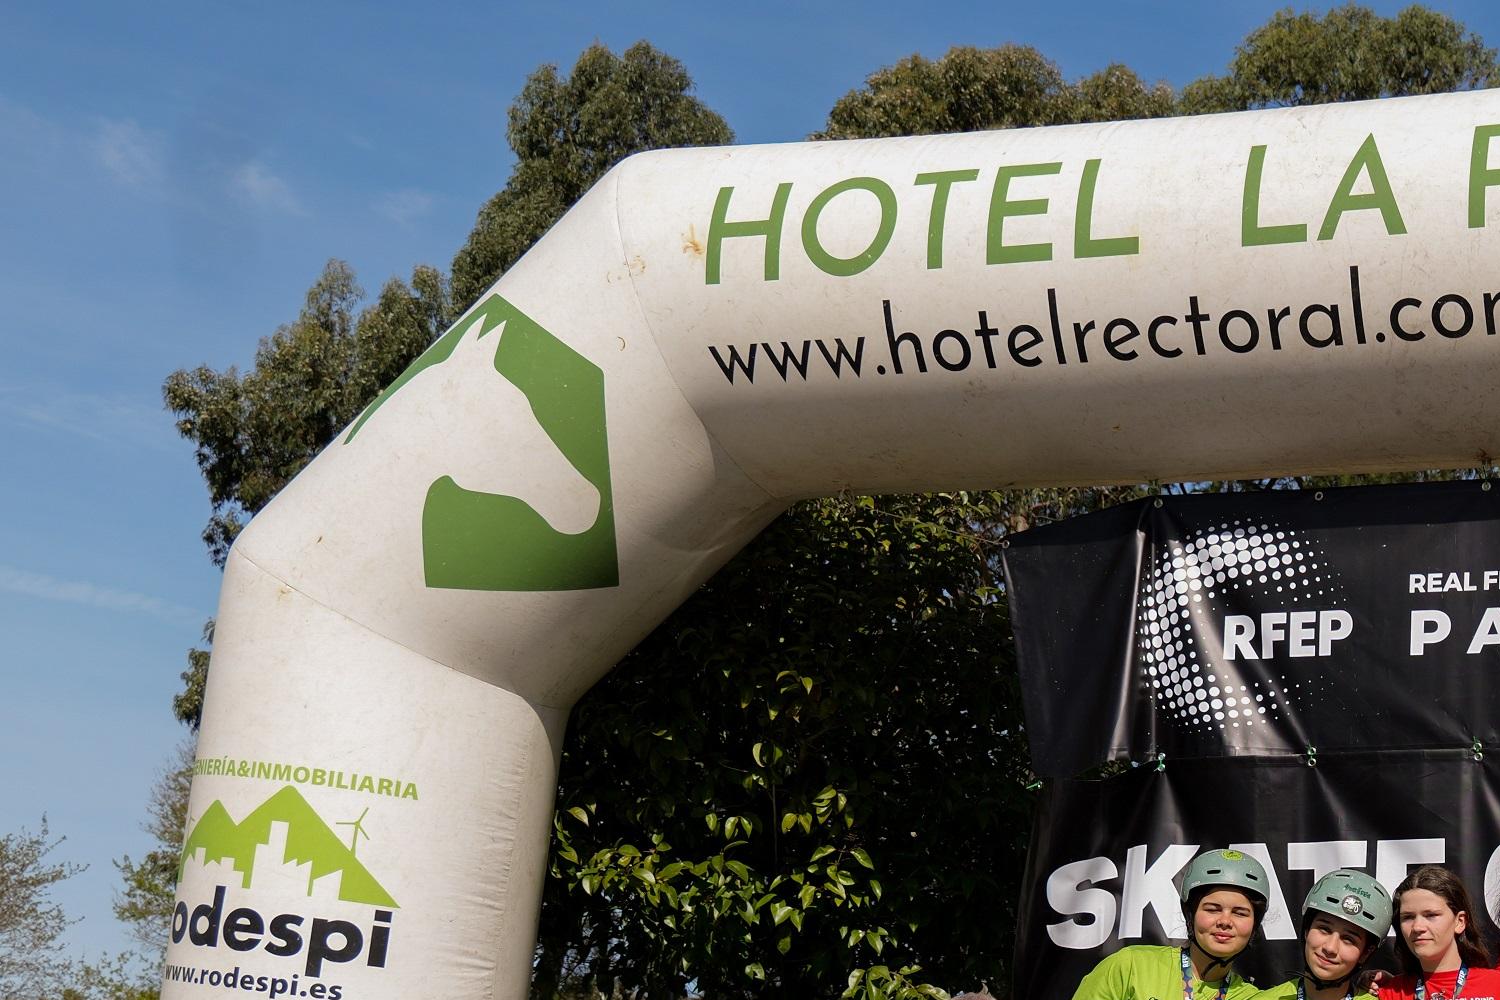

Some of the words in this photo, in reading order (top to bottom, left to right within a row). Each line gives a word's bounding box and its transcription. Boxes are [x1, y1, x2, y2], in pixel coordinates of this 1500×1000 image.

[705, 159, 1140, 285] HOTEL
[1241, 133, 1407, 247] LA
[1409, 571, 1477, 594] REAL
[1223, 610, 1354, 661] RFEP
[172, 885, 393, 978] odespi
